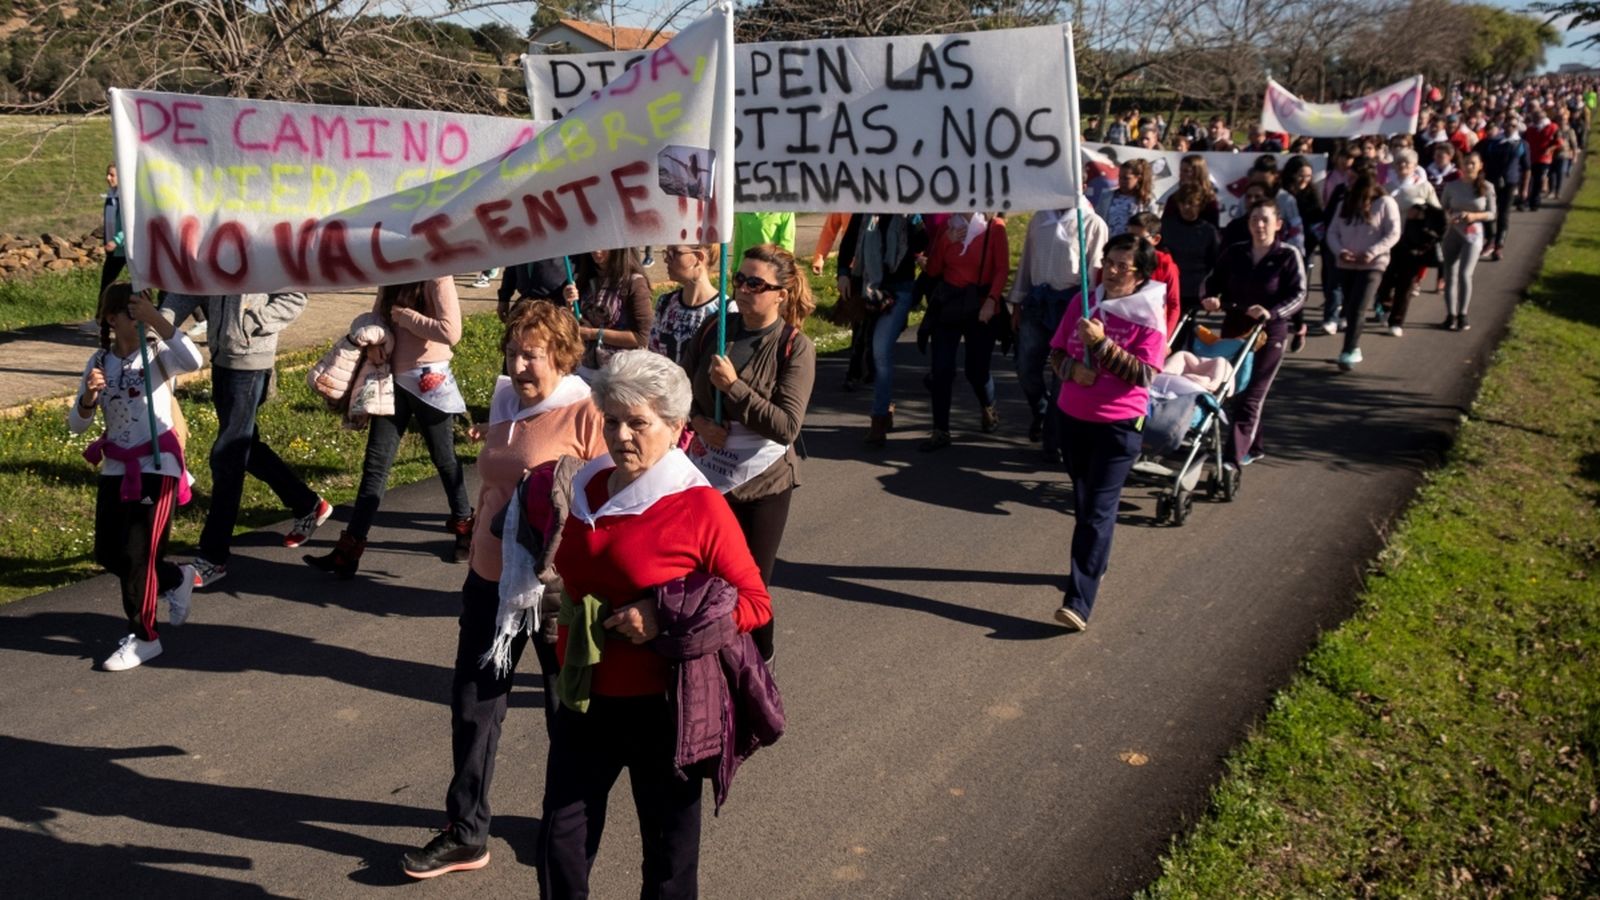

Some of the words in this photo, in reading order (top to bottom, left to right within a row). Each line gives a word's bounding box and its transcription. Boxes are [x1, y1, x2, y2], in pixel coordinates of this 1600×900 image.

[885, 39, 974, 91] LAS
[135, 98, 208, 145] DE
[232, 107, 470, 166] CAMINO
[940, 105, 1062, 168] NOS
[138, 158, 372, 217] QUIERO
[146, 214, 249, 291] NO
